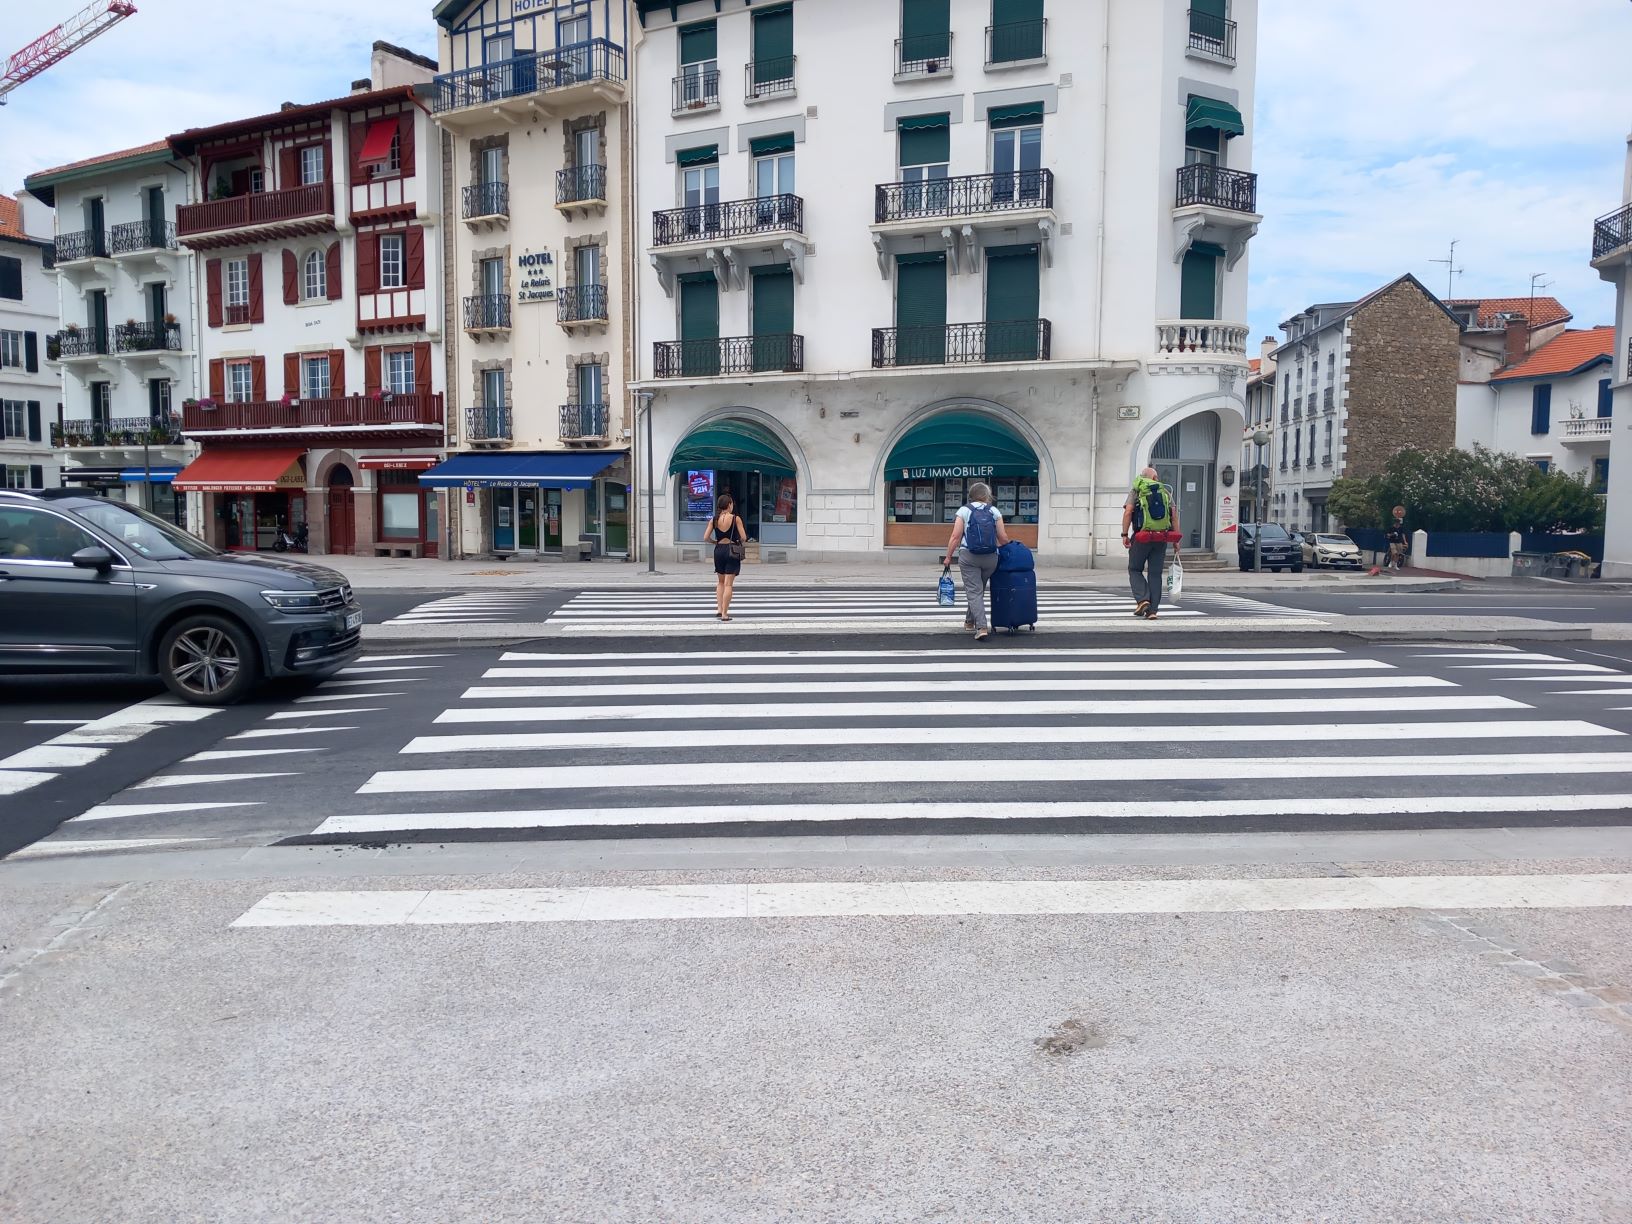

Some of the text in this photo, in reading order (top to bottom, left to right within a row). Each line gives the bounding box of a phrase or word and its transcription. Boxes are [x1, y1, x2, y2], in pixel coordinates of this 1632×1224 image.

[518, 252, 553, 267] HOTEL
[521, 276, 551, 288] Le Relais
[518, 290, 554, 300] St Jacques
[911, 466, 994, 478] LUZ IMMOBILIER
[692, 485, 708, 495] 72H
